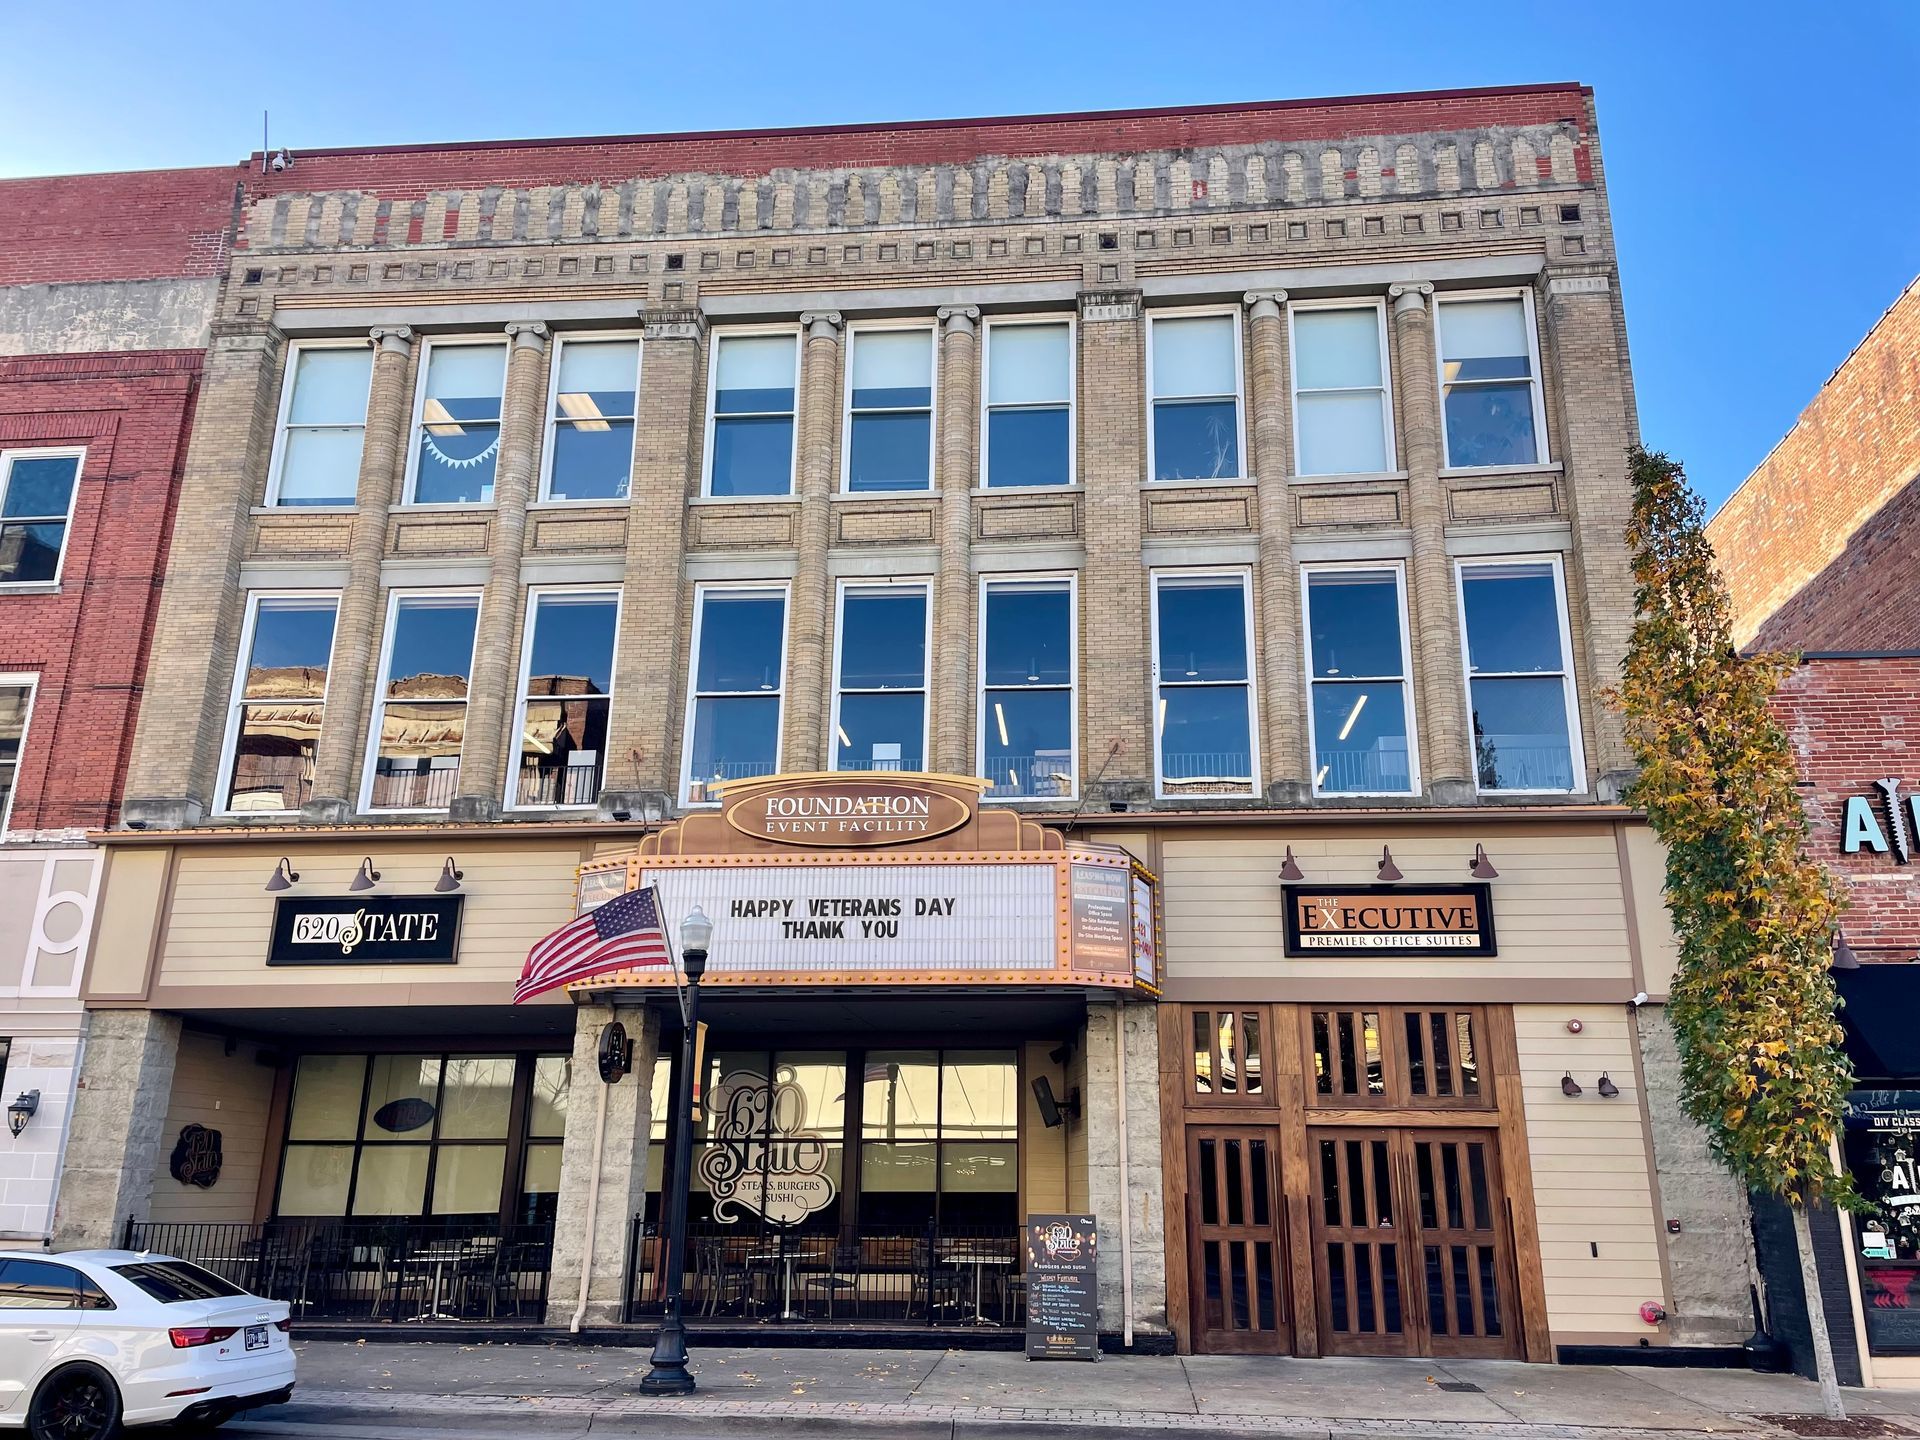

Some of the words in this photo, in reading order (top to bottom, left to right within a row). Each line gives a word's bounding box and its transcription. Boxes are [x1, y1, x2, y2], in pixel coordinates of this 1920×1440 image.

[766, 796, 931, 816] FOUNDATION
[766, 821, 829, 833] EVENT
[839, 820, 929, 832] FACILITY
[730, 899, 794, 917] HAPPY
[808, 898, 901, 916] VETERANS
[915, 897, 955, 916] DAY
[1317, 898, 1338, 907] THE
[1301, 905, 1474, 930] EXECUTIVE
[297, 916, 340, 940] 620
[339, 908, 439, 954] STATE
[782, 920, 844, 939] THANK
[861, 920, 899, 939] YOU
[1309, 936, 1365, 946] PREMIER
[1373, 935, 1421, 946] OFFICE
[1426, 935, 1472, 946] SUITES
[731, 1087, 802, 1135] 620
[1874, 1117, 1889, 1127] DIY
[704, 1122, 822, 1194] State
[777, 1181, 820, 1192] BURGERS
[765, 1194, 794, 1203] SUSHI
